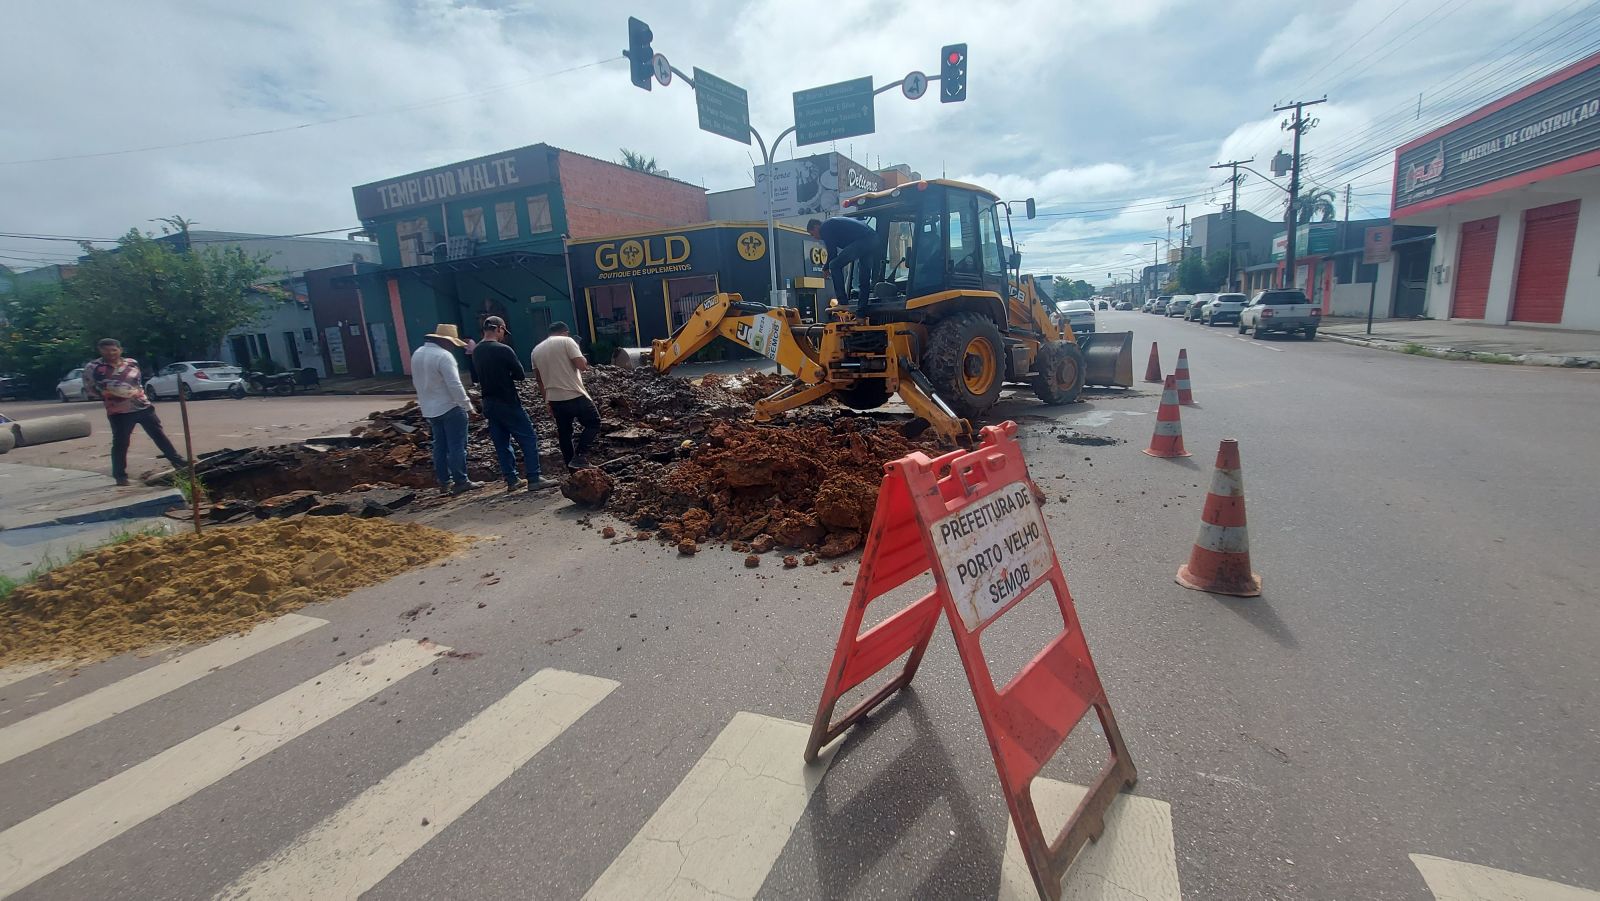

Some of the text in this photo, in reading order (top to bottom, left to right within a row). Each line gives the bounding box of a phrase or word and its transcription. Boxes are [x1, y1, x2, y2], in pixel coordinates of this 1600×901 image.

[1460, 99, 1600, 164] MATERIAL DE CONSTRUÇÃO
[377, 156, 520, 210] TEMPLO DO MALTE
[595, 235, 691, 272] GOLD
[598, 263, 692, 280] BOUTIQUE DE SUPLEMENTOS
[811, 247, 828, 265] GO
[769, 324, 781, 360] SEMOB
[940, 487, 1031, 545] PREFEITURA DE
[956, 521, 1040, 585] PORTO VELHO
[989, 563, 1031, 604] SEMOB
